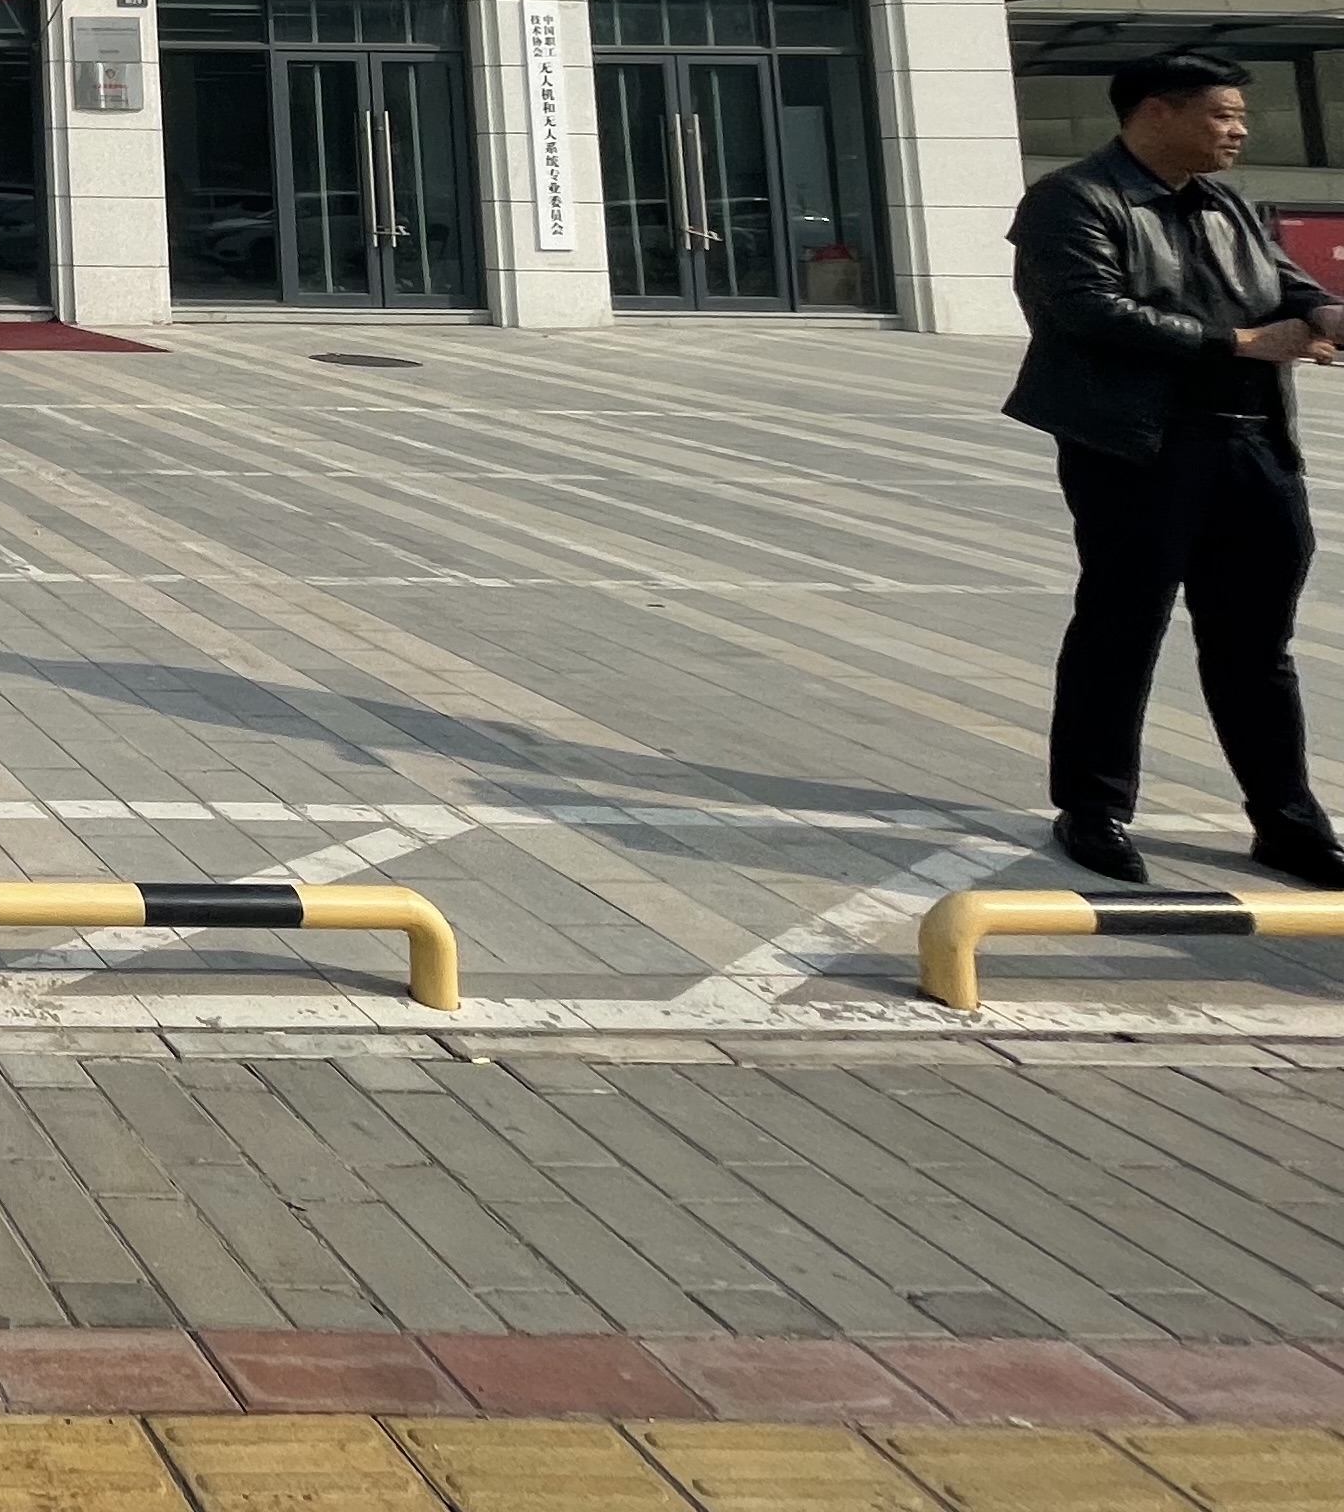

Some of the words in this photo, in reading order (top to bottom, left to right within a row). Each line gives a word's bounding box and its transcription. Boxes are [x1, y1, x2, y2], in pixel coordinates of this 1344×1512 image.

[539, 61, 564, 236] 无人机和无人系统专业委员会
